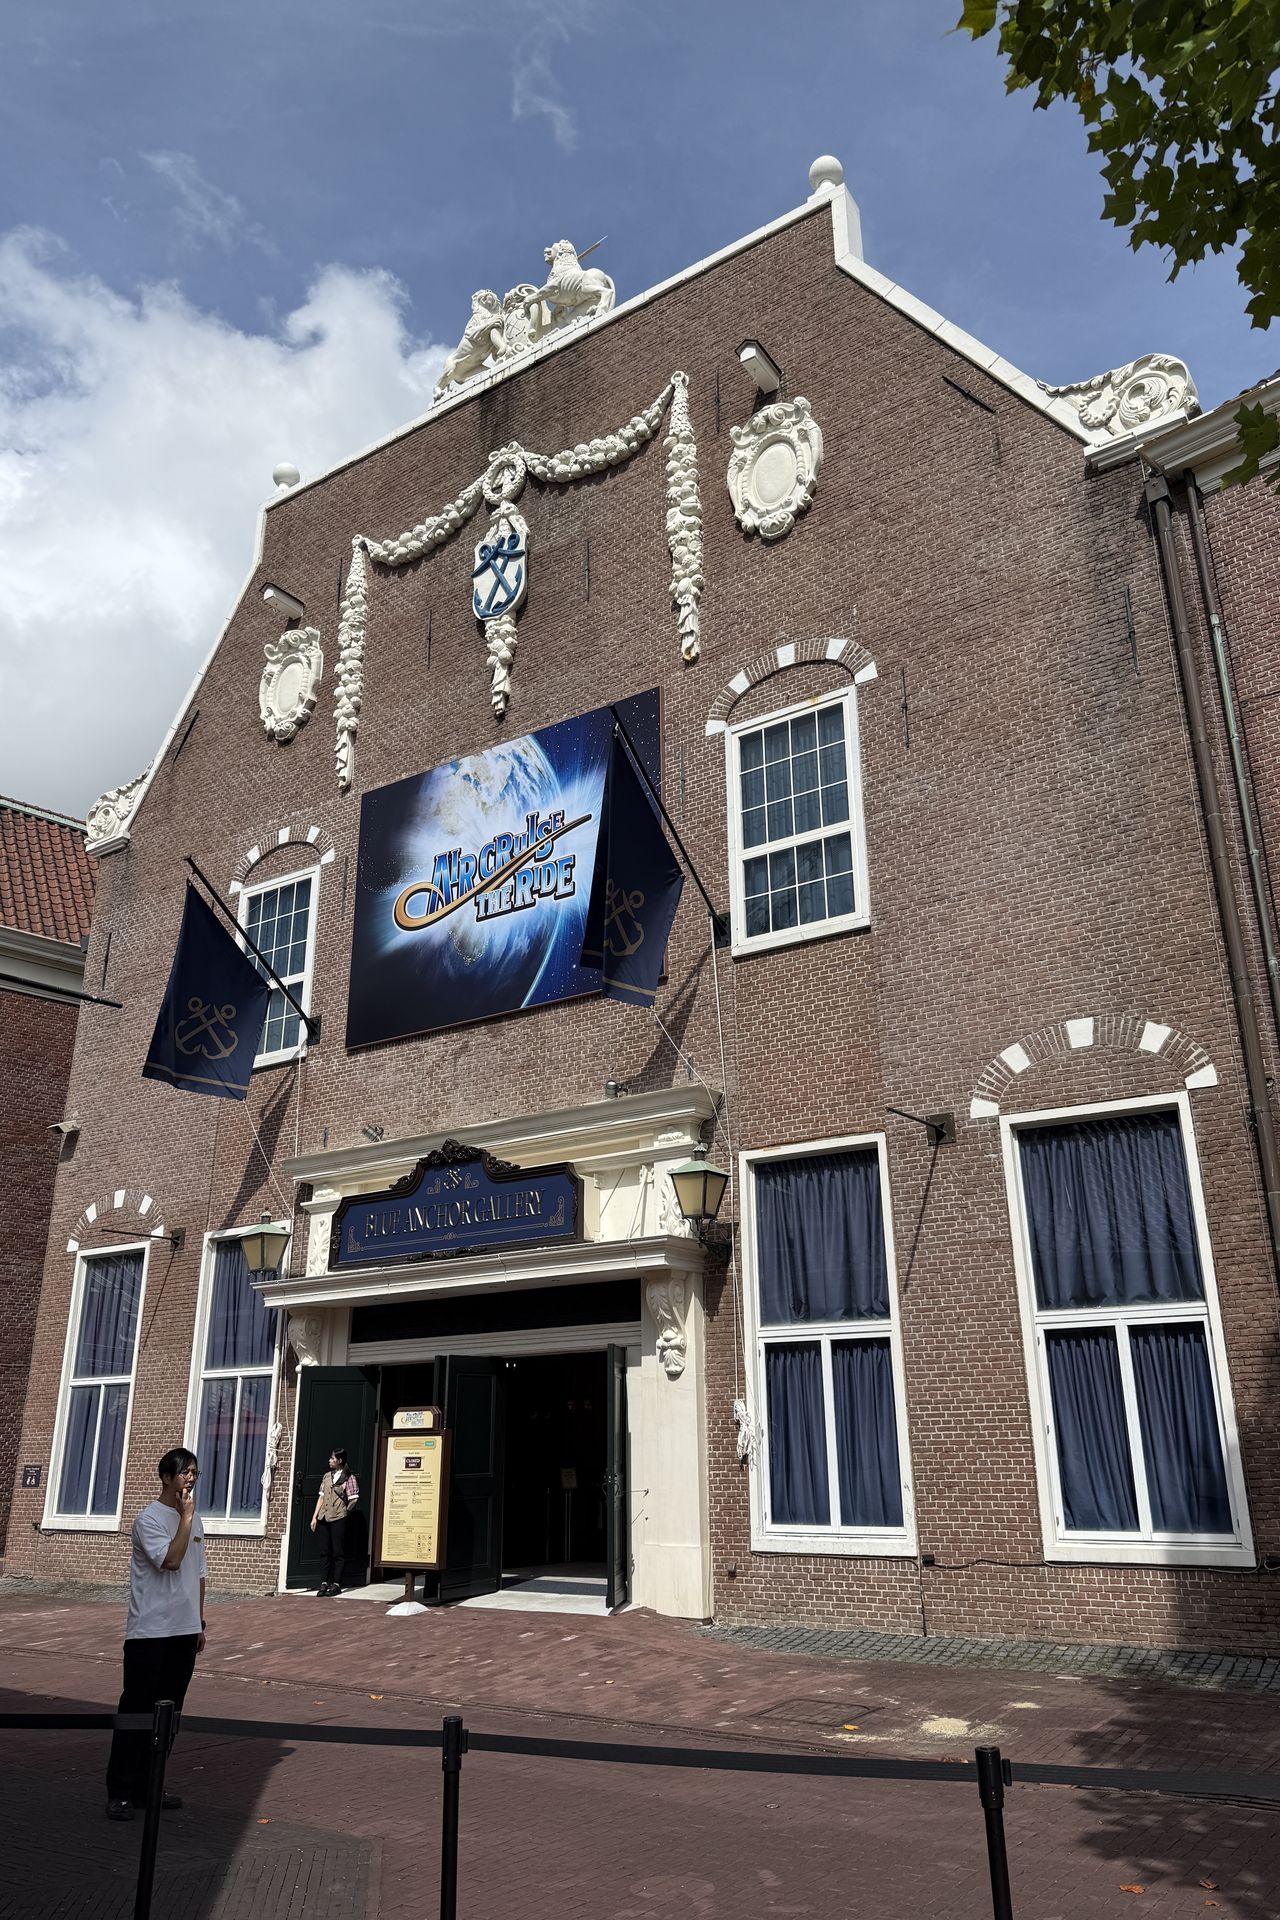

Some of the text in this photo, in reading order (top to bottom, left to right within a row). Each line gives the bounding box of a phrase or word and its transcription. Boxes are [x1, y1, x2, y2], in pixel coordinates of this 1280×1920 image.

[426, 809, 565, 917] AIR CRUISE
[476, 853, 576, 921] THE RIDE
[365, 1188, 546, 1238] BLUE ANCHOR GALLERY
